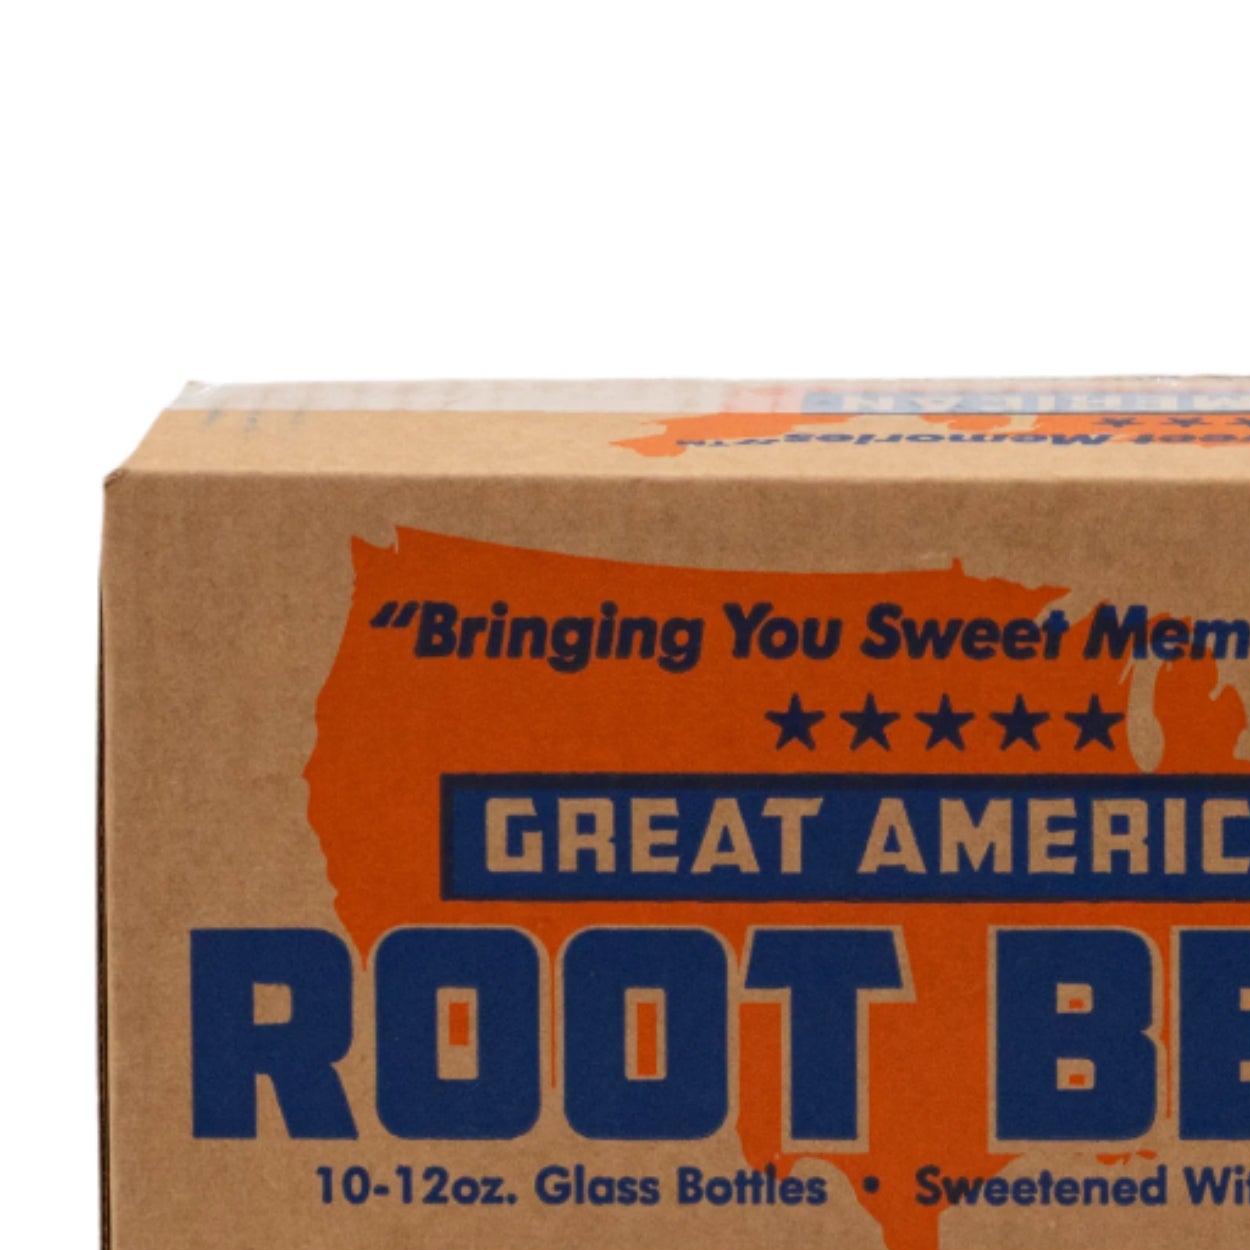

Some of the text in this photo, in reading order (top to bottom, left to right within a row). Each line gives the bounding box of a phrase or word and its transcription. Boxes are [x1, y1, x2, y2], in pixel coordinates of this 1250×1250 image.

[723, 602, 843, 660] You
[860, 602, 1070, 661] Sweet
[485, 797, 823, 874] GREAT
[190, 927, 904, 1141] ROOT
[316, 1165, 518, 1206] 10-12oz.
[535, 1164, 661, 1206] Glass
[677, 1164, 828, 1206] Bottles
[915, 1165, 1168, 1207] Sweetened
